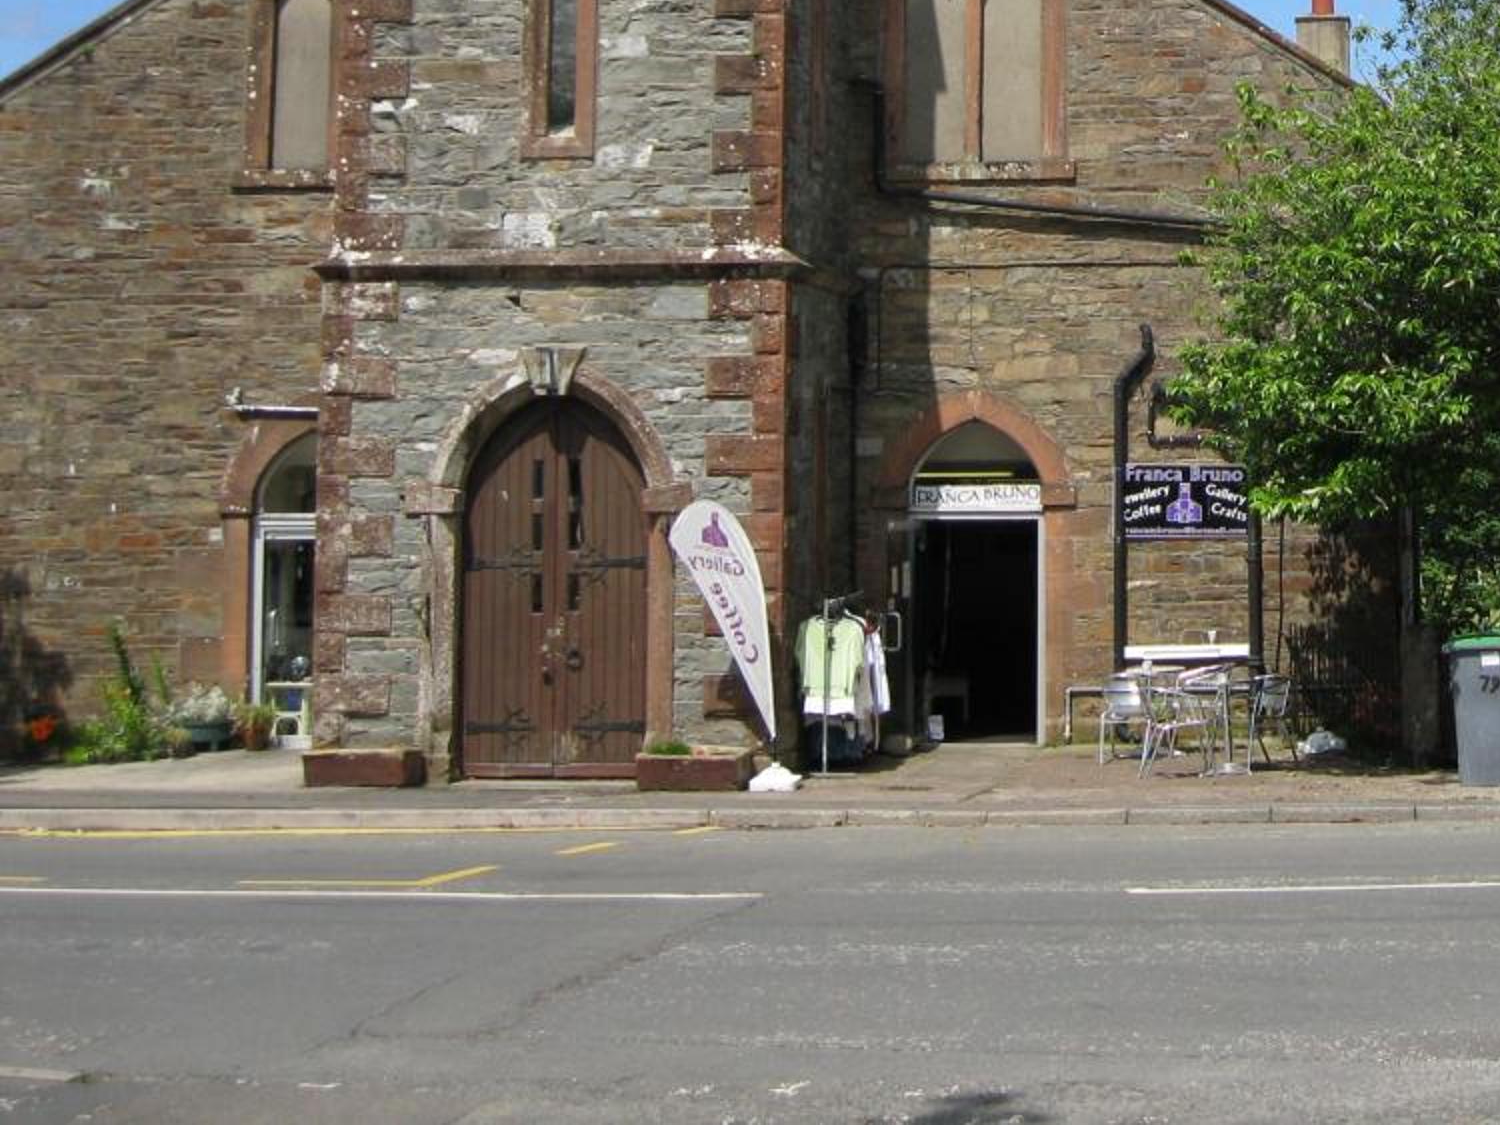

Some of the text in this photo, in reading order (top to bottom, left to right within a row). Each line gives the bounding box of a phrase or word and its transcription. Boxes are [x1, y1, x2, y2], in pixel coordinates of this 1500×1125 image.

[1125, 465, 1244, 482] Franca Bruno
[916, 485, 1040, 505] FRANCA BRUNO
[1124, 485, 1170, 505] ewellery
[1205, 483, 1247, 506] Gallery
[1123, 504, 1162, 522] Coffee
[1211, 502, 1248, 522] Crafts
